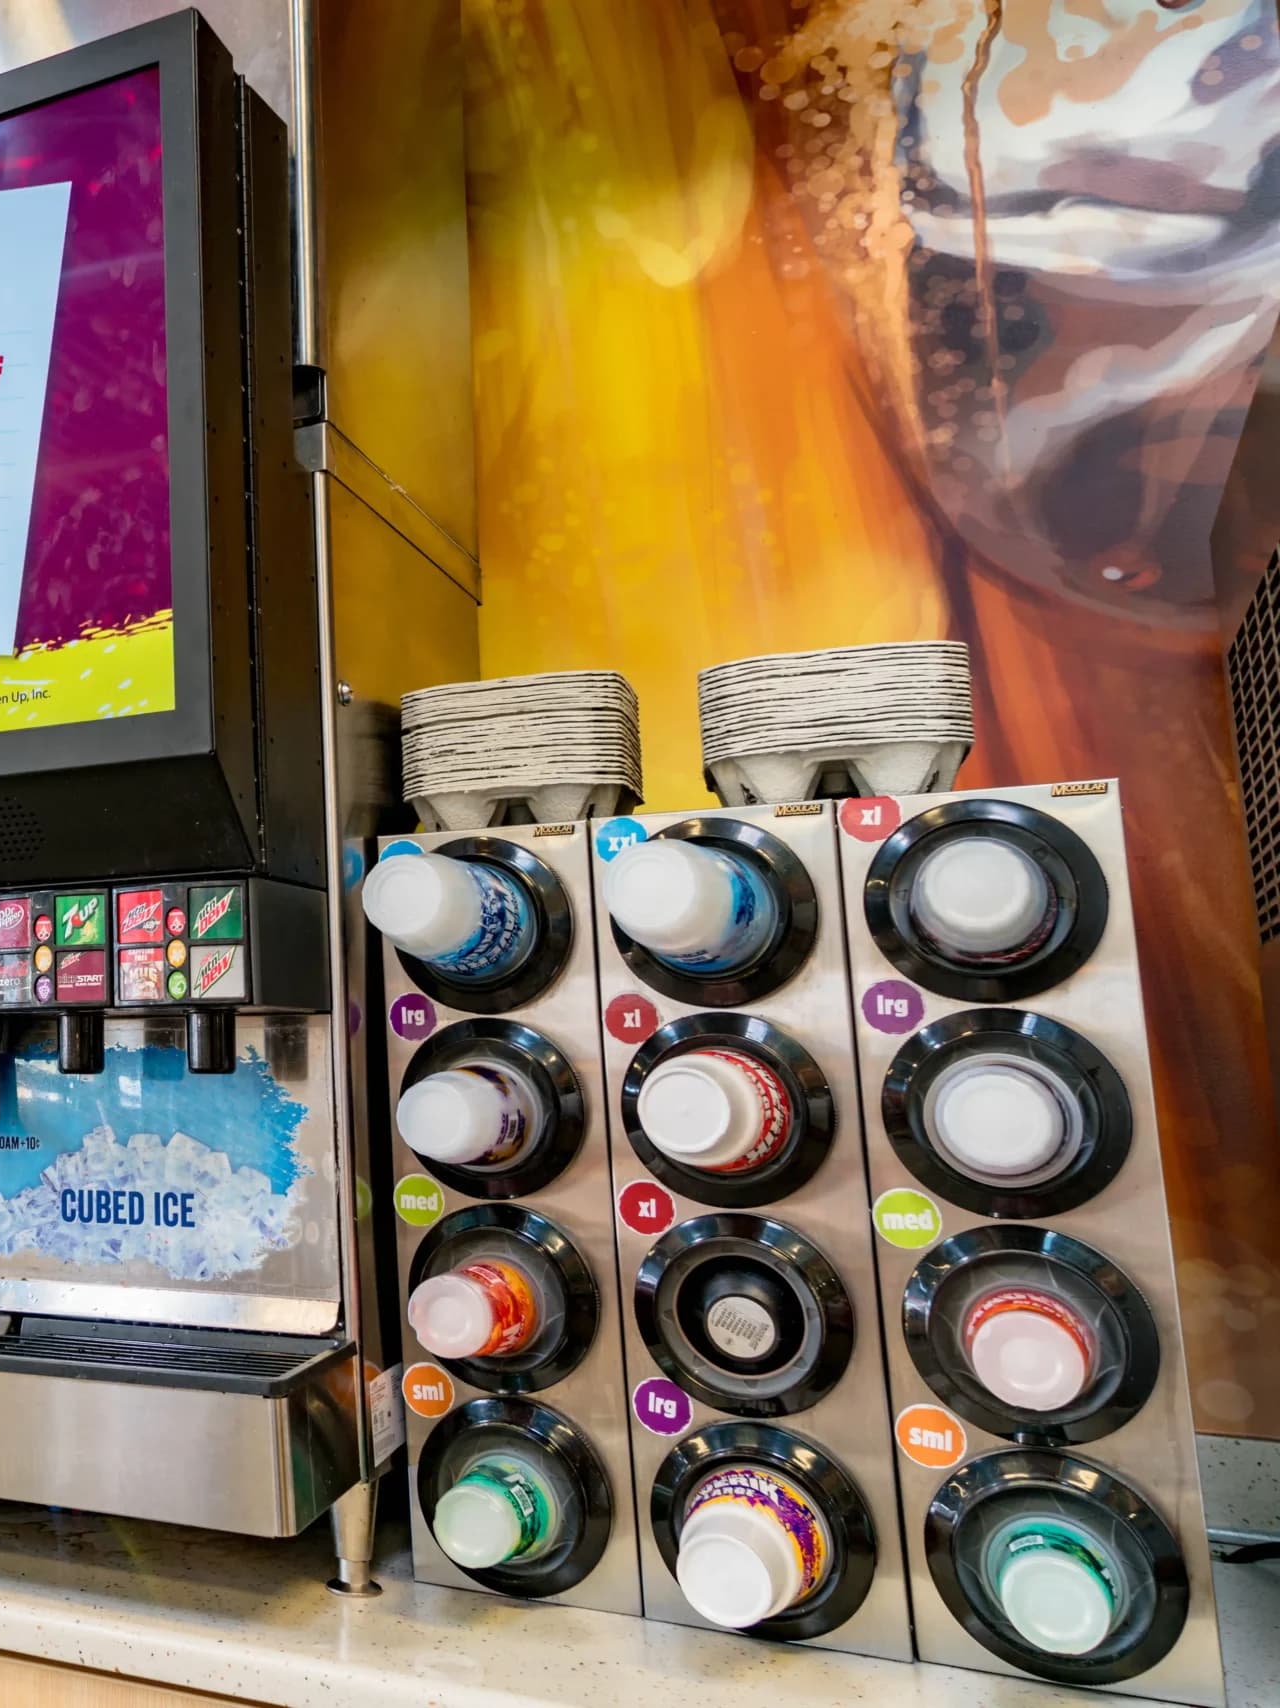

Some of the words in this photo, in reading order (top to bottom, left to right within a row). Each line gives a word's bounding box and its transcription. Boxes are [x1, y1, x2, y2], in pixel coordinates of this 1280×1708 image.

[11, 691, 29, 705] Up,
[32, 688, 51, 700] Inc.
[1051, 783, 1108, 797] MODULAR
[775, 804, 823, 817] MODULAR
[860, 806, 881, 826] xl
[0, 977, 21, 986] zero
[401, 1006, 425, 1026] lrg
[877, 994, 908, 1018] lrg
[623, 1009, 641, 1028] xl
[61, 1188, 144, 1225] CUBED
[154, 1192, 195, 1228] ICE
[400, 1193, 439, 1211] med
[638, 1198, 656, 1218] xl
[882, 1208, 934, 1231] med
[413, 1382, 445, 1401] sml
[648, 1392, 677, 1419] lrg
[908, 1427, 953, 1452] sml
